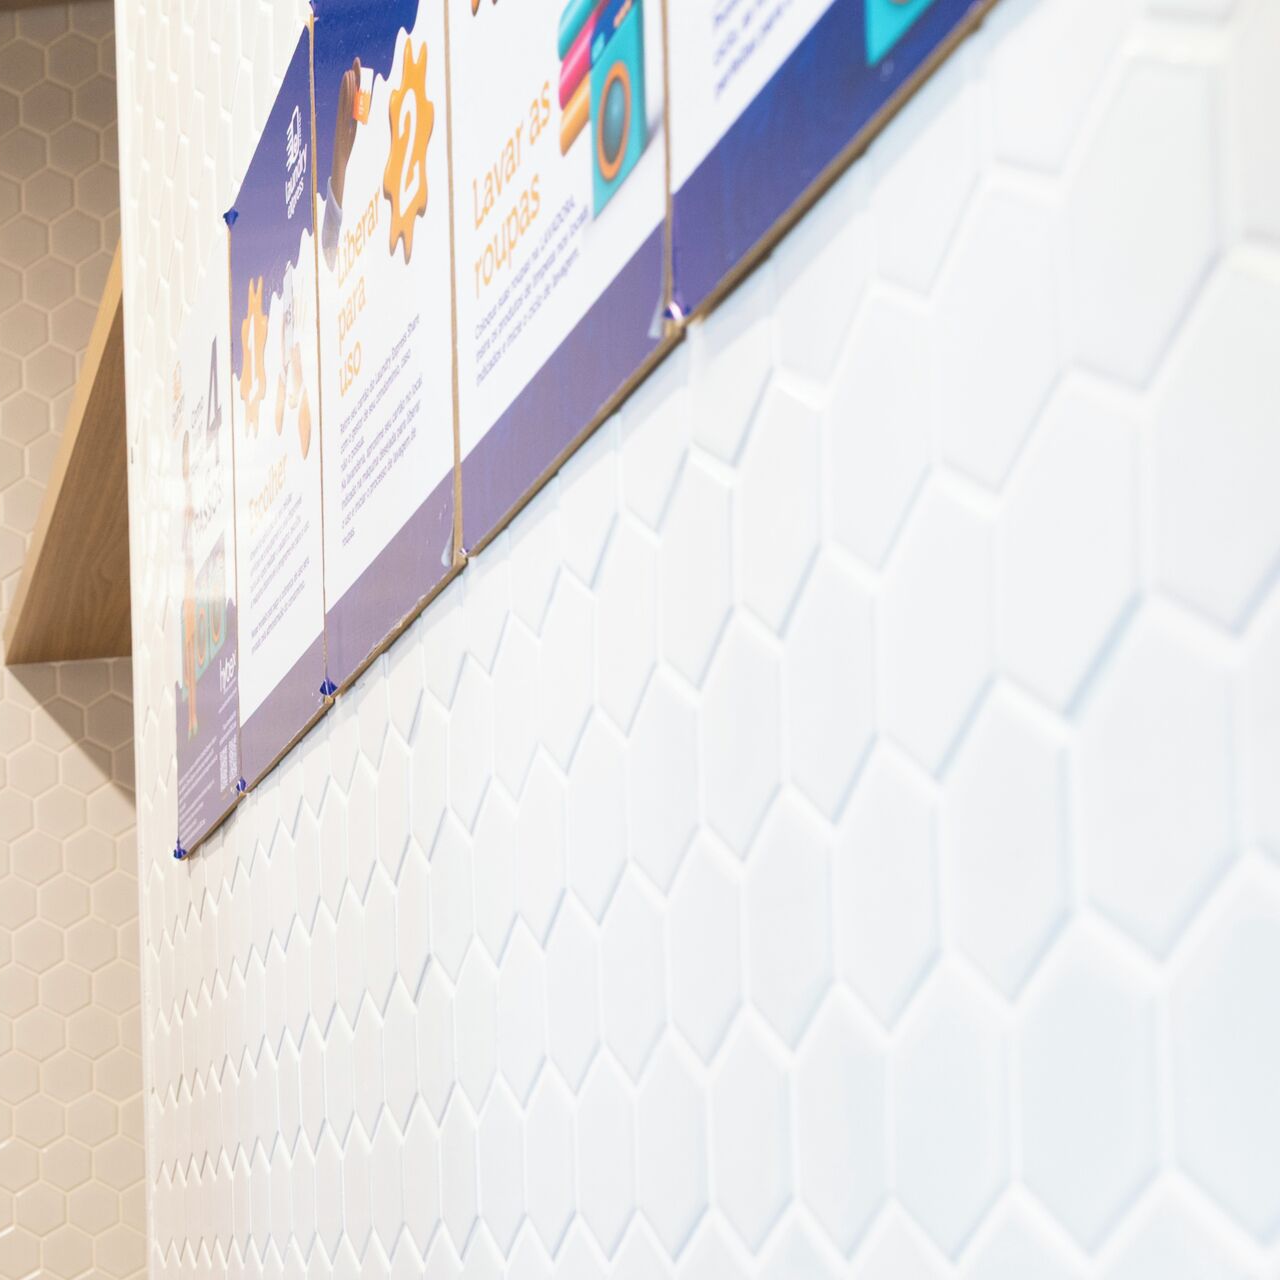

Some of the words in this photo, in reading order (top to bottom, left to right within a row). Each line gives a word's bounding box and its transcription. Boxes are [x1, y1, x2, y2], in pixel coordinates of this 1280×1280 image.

[398, 87, 422, 218] 2
[472, 115, 526, 230] Lavar
[529, 79, 552, 144] as
[474, 173, 541, 300] roupas
[338, 275, 367, 356] para
[339, 341, 362, 398] uso
